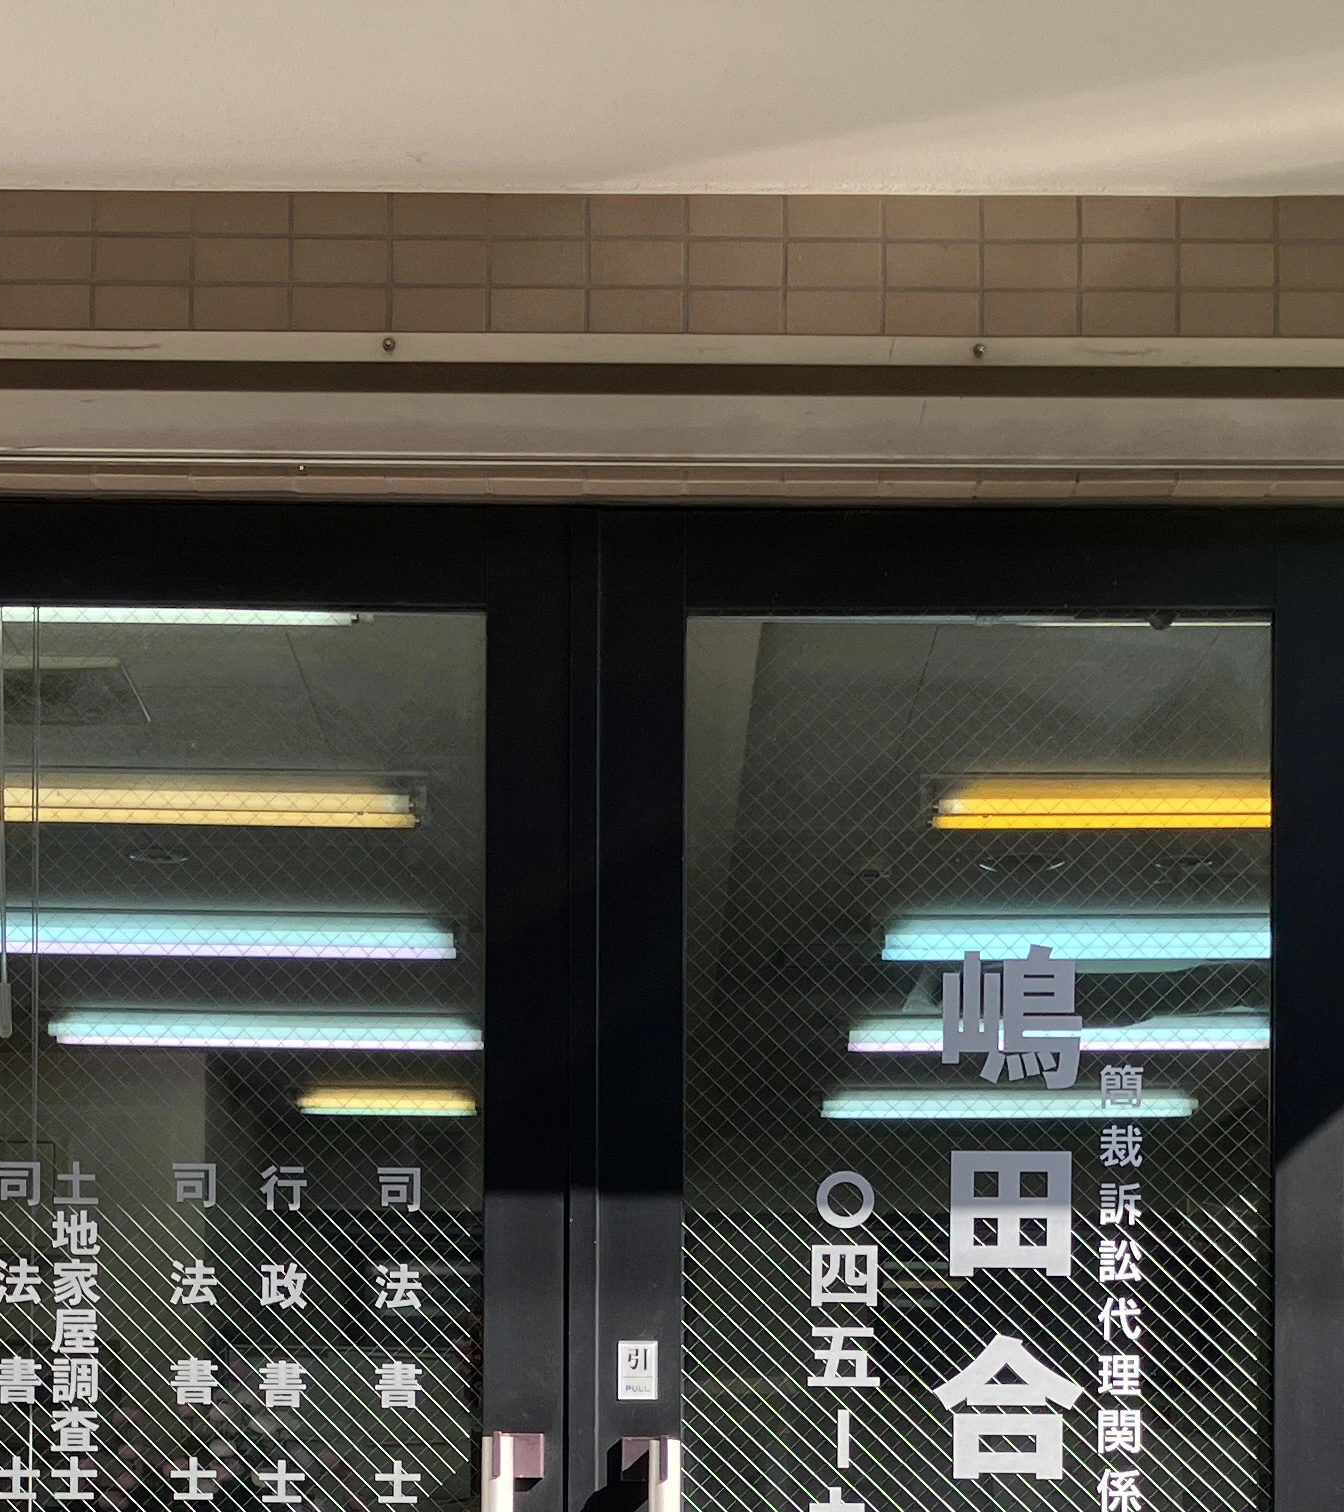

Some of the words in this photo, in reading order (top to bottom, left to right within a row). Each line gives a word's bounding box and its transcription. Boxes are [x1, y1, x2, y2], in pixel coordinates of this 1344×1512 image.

[51, 1161, 100, 1500] 土地家屋調査士
[170, 1163, 218, 1500] 司法書士
[259, 1165, 308, 1503] 行政書士
[374, 1166, 422, 1504] 司法書士
[628, 1348, 648, 1370] 引
